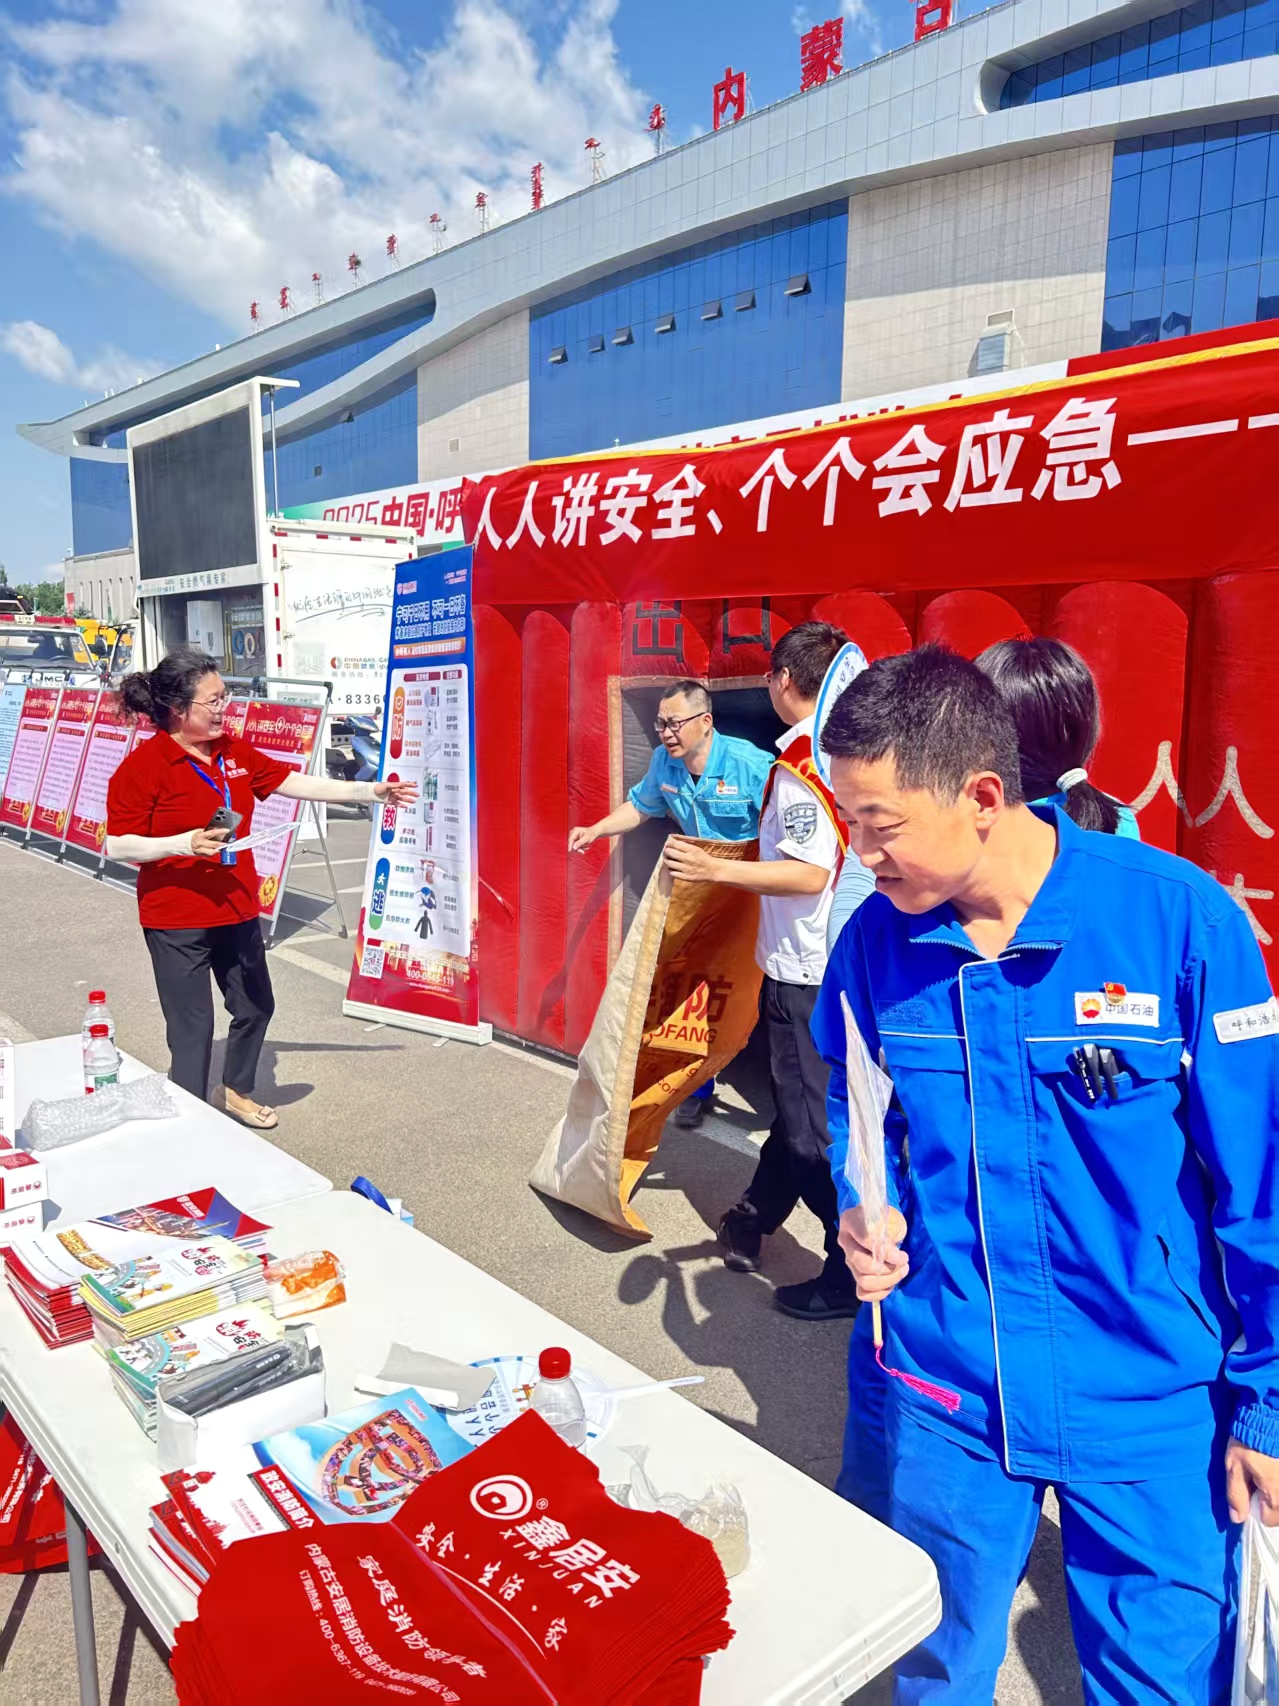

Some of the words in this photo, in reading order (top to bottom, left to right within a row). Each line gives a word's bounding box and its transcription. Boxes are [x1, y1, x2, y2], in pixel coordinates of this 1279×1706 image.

[474, 396, 1279, 551] 人人讲安全、个个会应急—
[632, 596, 772, 663] 出口
[1105, 1003, 1154, 1017] 中国石油
[1231, 1009, 1279, 1031] 呼和浩
[499, 1528, 603, 1608] XINJUAN
[515, 1515, 641, 1598] 鑫居安
